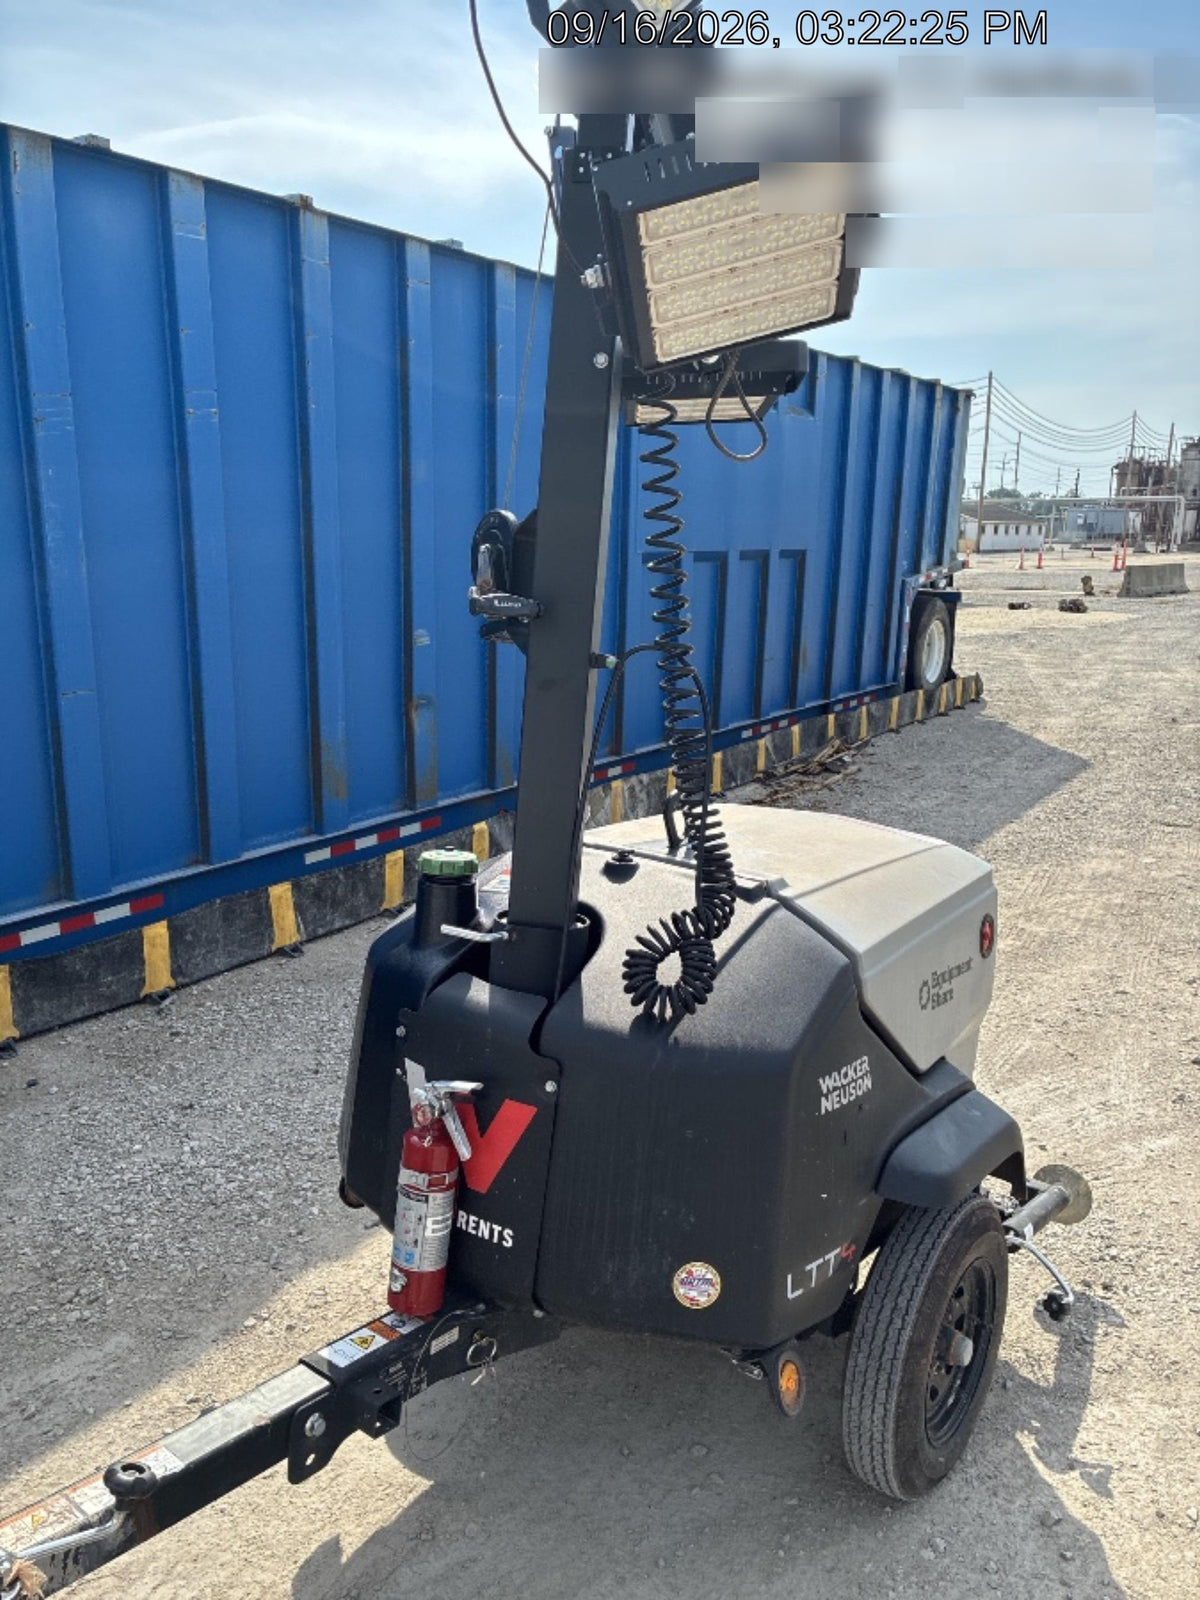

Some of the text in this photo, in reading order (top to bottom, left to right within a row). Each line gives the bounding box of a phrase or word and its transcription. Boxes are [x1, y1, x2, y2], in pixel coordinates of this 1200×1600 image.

[818, 1055, 870, 1094] WACKER
[821, 1073, 872, 1115] NEUSON
[456, 1210, 514, 1248] RENTS
